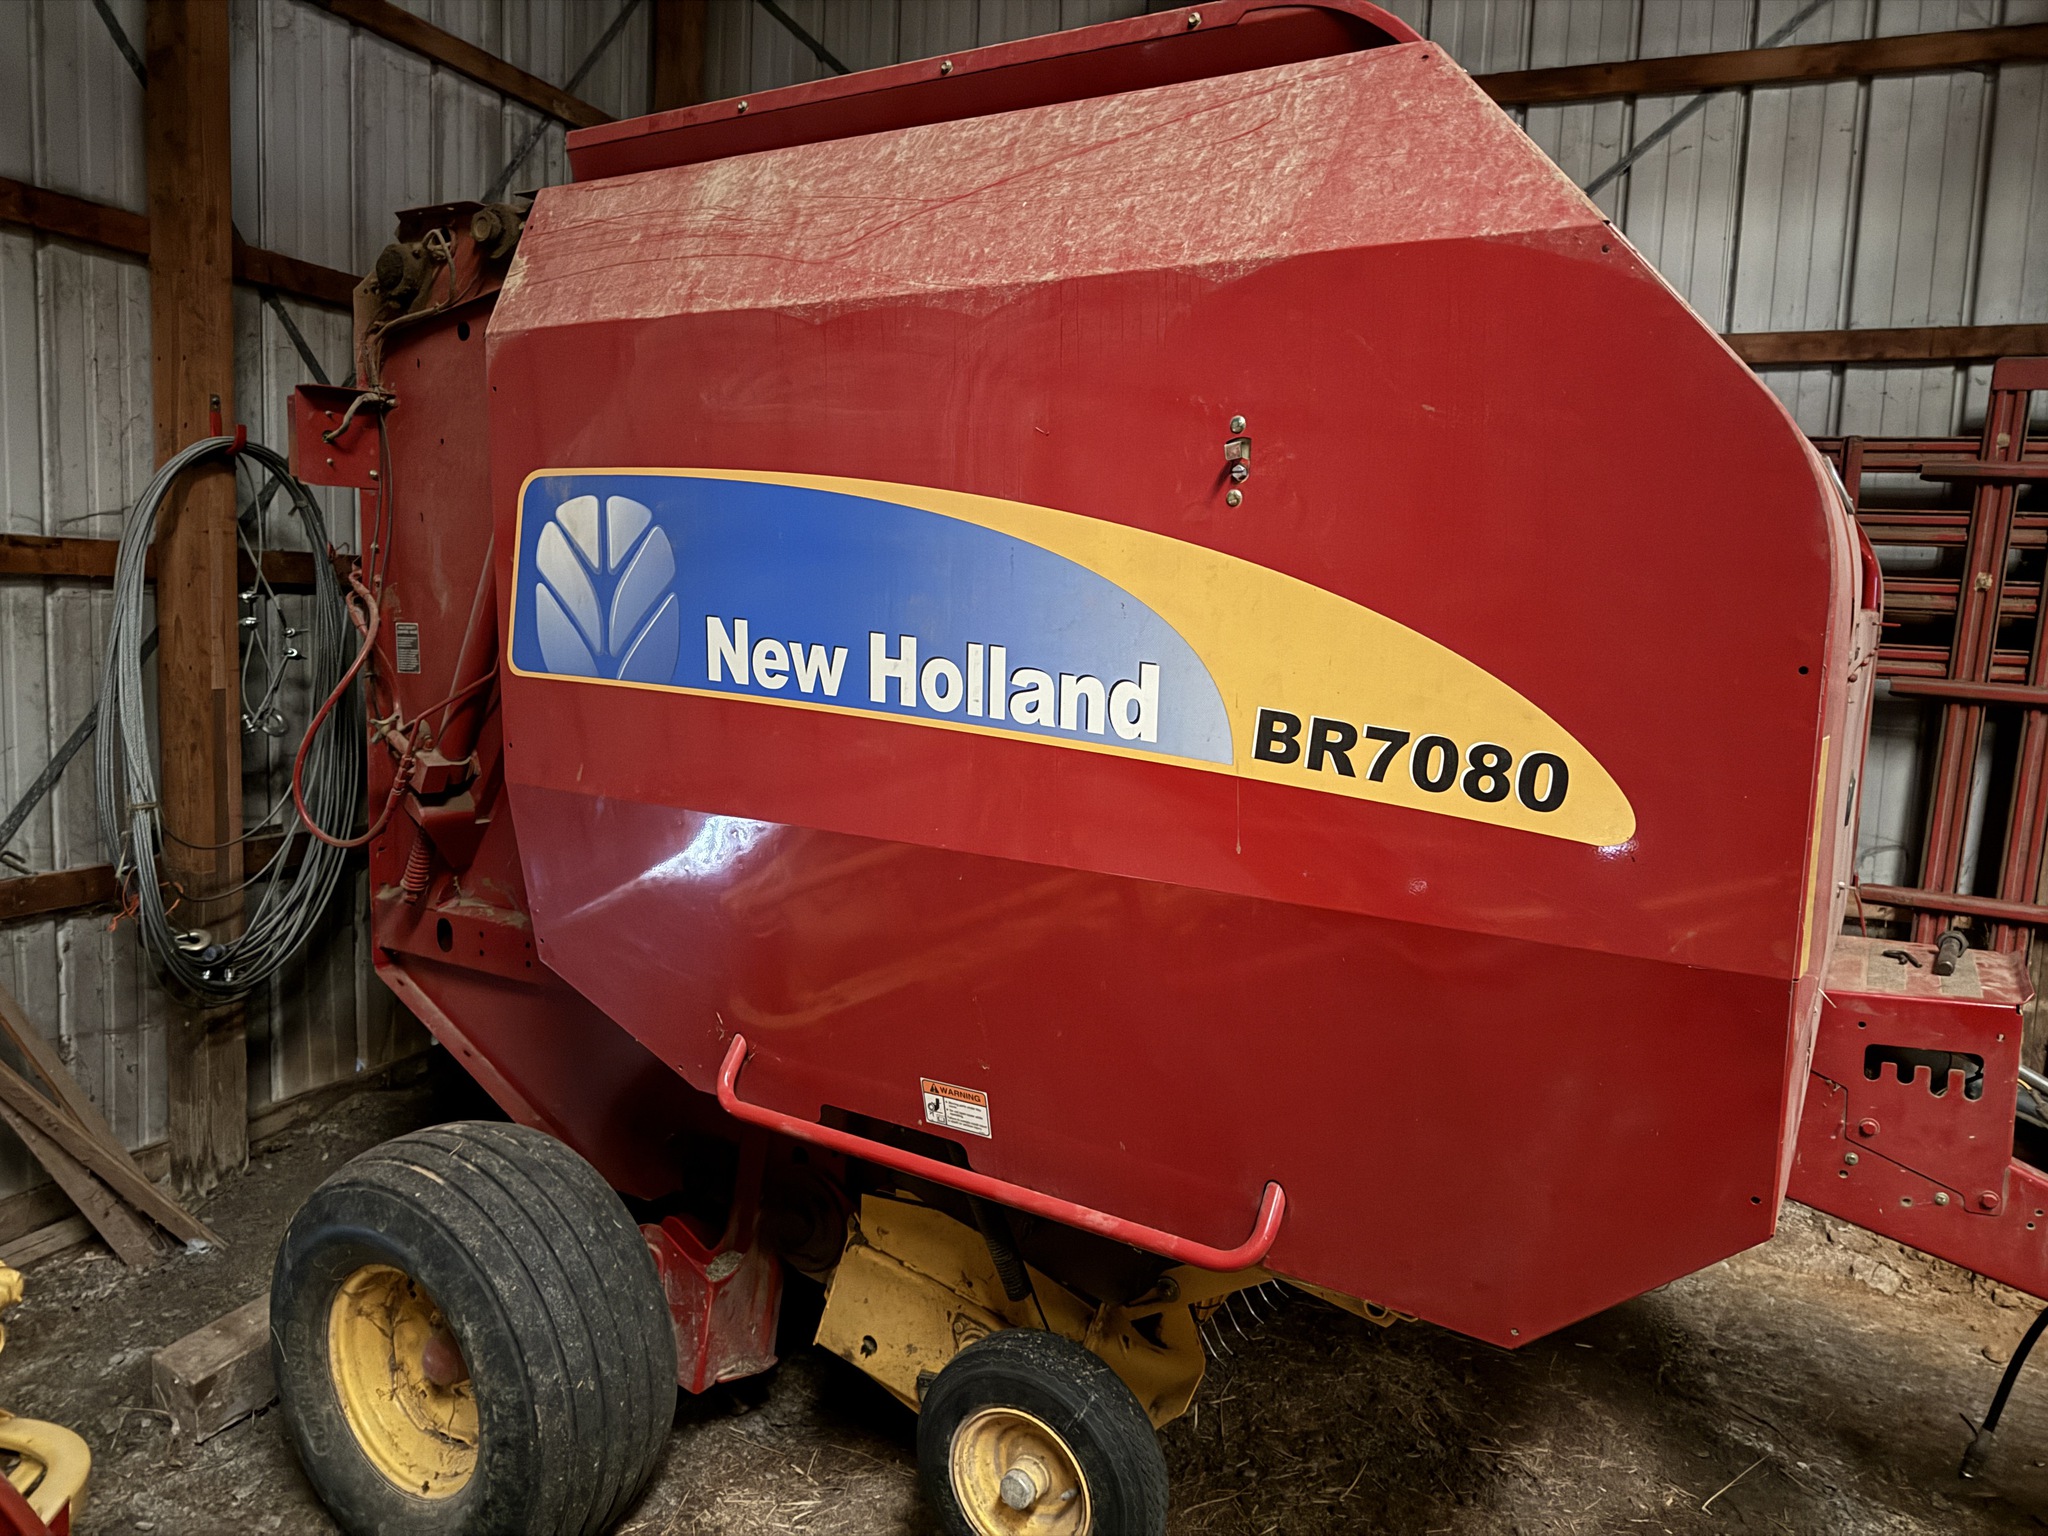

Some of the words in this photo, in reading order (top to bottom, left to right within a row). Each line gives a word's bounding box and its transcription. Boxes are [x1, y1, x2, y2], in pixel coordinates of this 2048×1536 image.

[706, 615, 849, 698] New
[869, 631, 1160, 743] Holland
[1253, 707, 1570, 813] BR7080
[939, 1086, 981, 1103] WARNING
